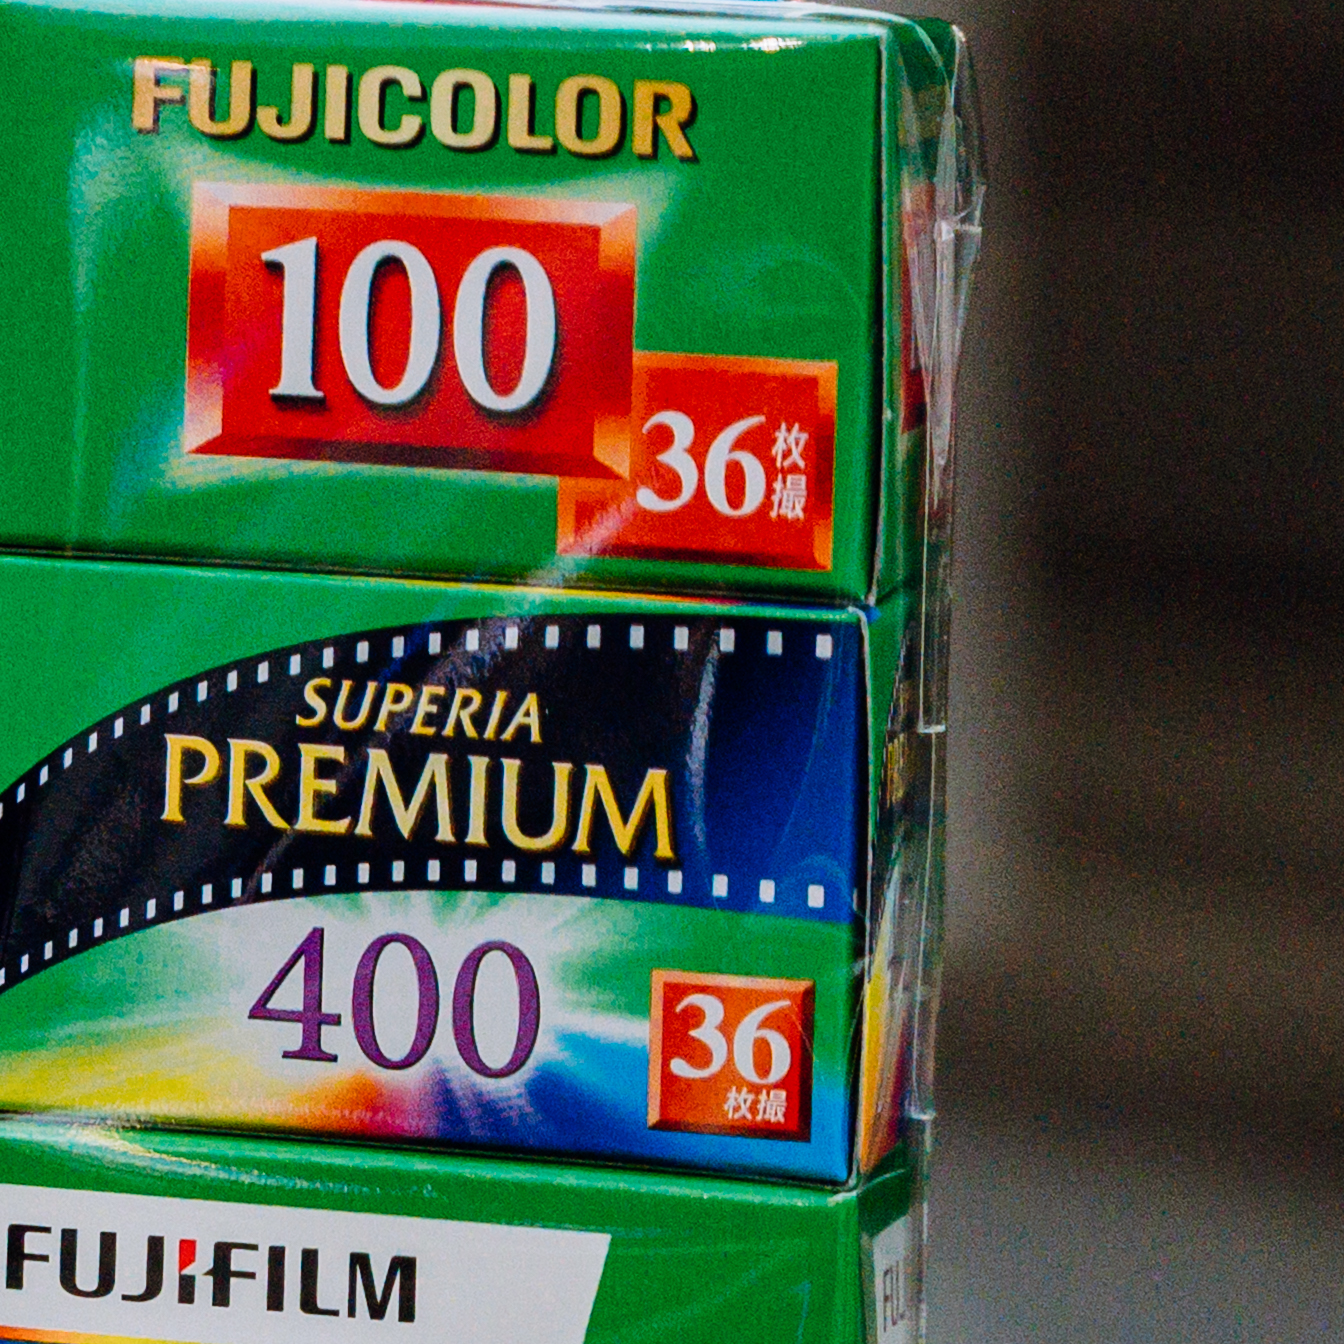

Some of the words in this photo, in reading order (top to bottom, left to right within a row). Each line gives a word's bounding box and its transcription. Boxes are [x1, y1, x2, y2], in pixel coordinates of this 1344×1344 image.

[130, 57, 697, 160] FUJICOLOR
[261, 236, 558, 413] 100
[636, 409, 767, 518] 36
[771, 421, 810, 521] 枚撮
[295, 677, 544, 744] SUPERIA
[160, 733, 675, 859] PREMIUM
[247, 925, 541, 1080] 400
[669, 992, 792, 1085] 36
[724, 1085, 788, 1125] 枚撮
[3, 1222, 418, 1324] FUJIFILM
